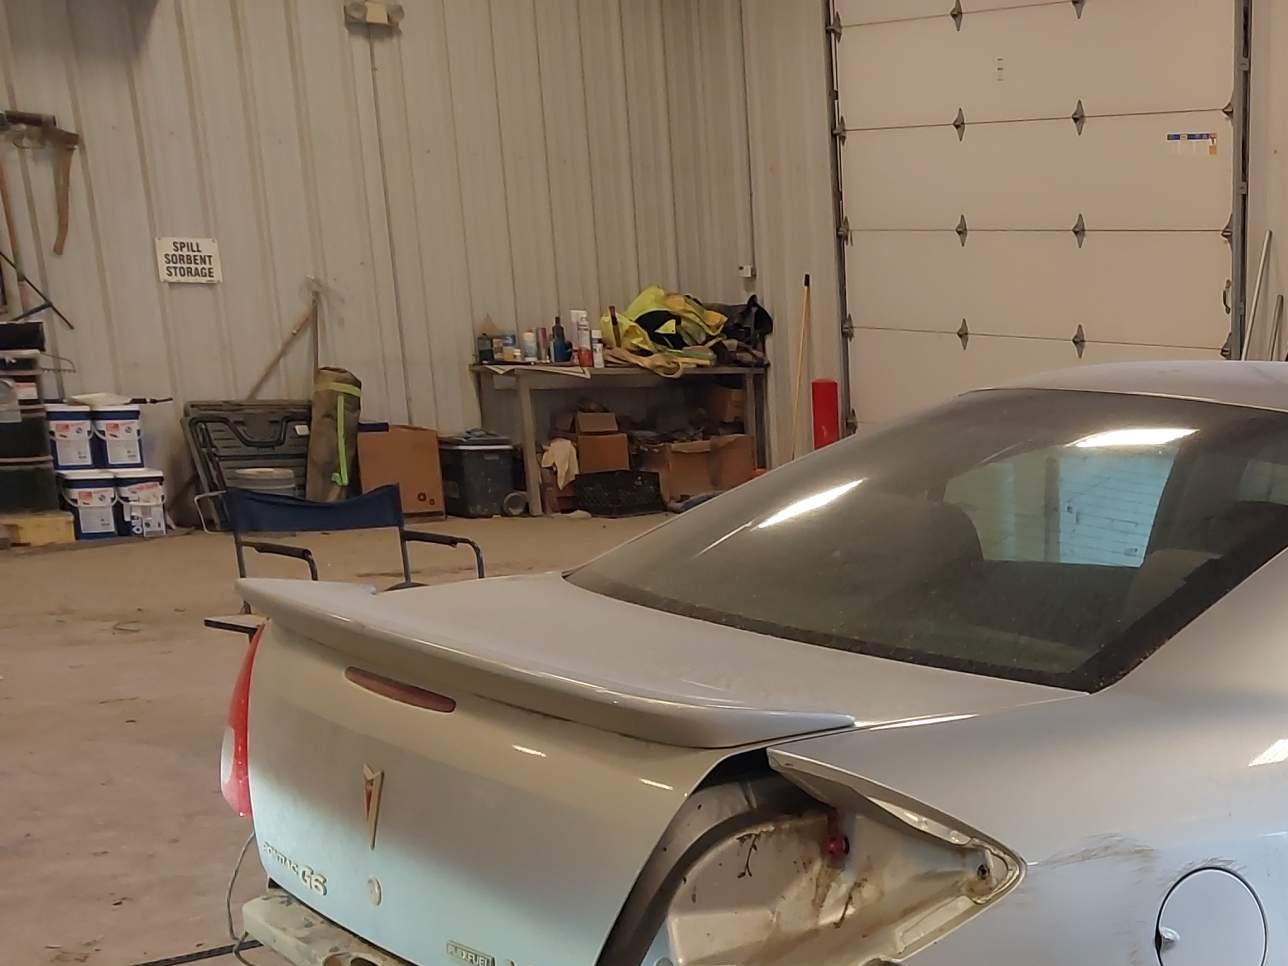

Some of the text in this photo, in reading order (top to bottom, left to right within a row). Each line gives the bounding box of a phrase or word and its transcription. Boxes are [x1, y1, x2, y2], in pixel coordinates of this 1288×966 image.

[172, 241, 202, 253] SPILL
[164, 253, 213, 265] SORBENT
[166, 266, 214, 278] STORAGE
[300, 865, 329, 897] G6
